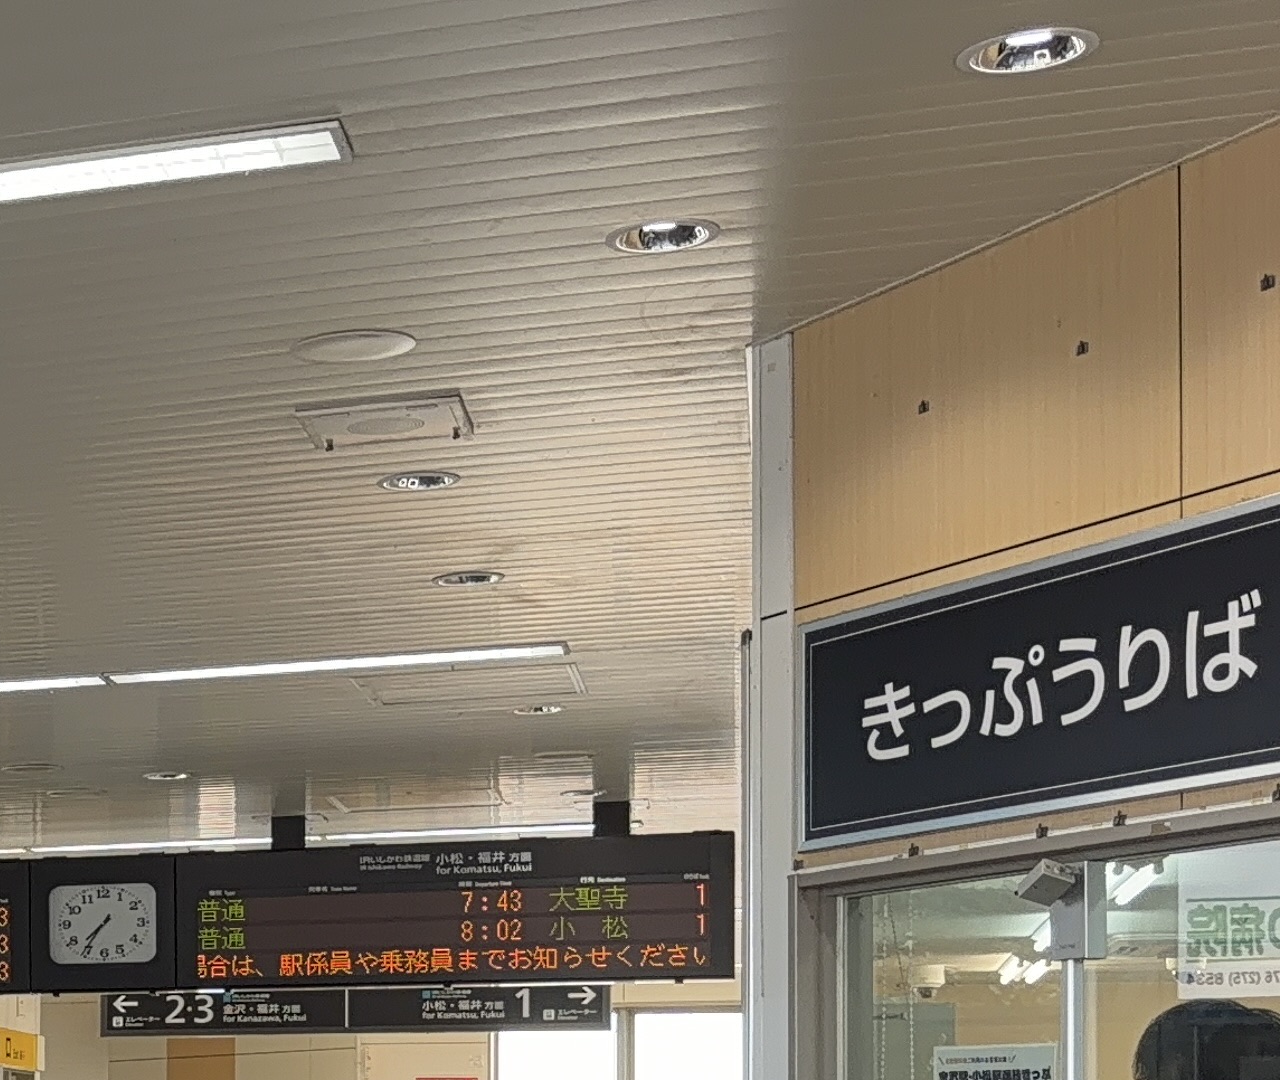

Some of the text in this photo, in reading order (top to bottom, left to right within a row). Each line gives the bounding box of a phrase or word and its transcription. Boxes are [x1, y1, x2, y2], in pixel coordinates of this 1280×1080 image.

[861, 589, 1261, 761] きっぷうりば
[436, 852, 505, 865] 小松・福井
[436, 866, 450, 875] for
[453, 864, 502, 874] Komatsu,
[503, 862, 532, 872] Fukui
[96, 889, 111, 899] 12
[117, 892, 123, 901] 1
[81, 895, 94, 905] 11
[197, 883, 705, 922] 普通 7:43 大聖寺 1
[69, 905, 81, 915] 10
[129, 901, 138, 910] 2
[62, 920, 71, 929] 9
[137, 917, 145, 927] 3
[198, 926, 246, 950] 普通
[460, 918, 522, 941] 8:02
[696, 914, 705, 936] 1
[69, 936, 78, 946] 8
[129, 934, 138, 943] 4
[99, 948, 109, 958] 6
[115, 944, 125, 955] 5
[422, 1000, 482, 1010] 小松・福井
[515, 988, 530, 1018] 1
